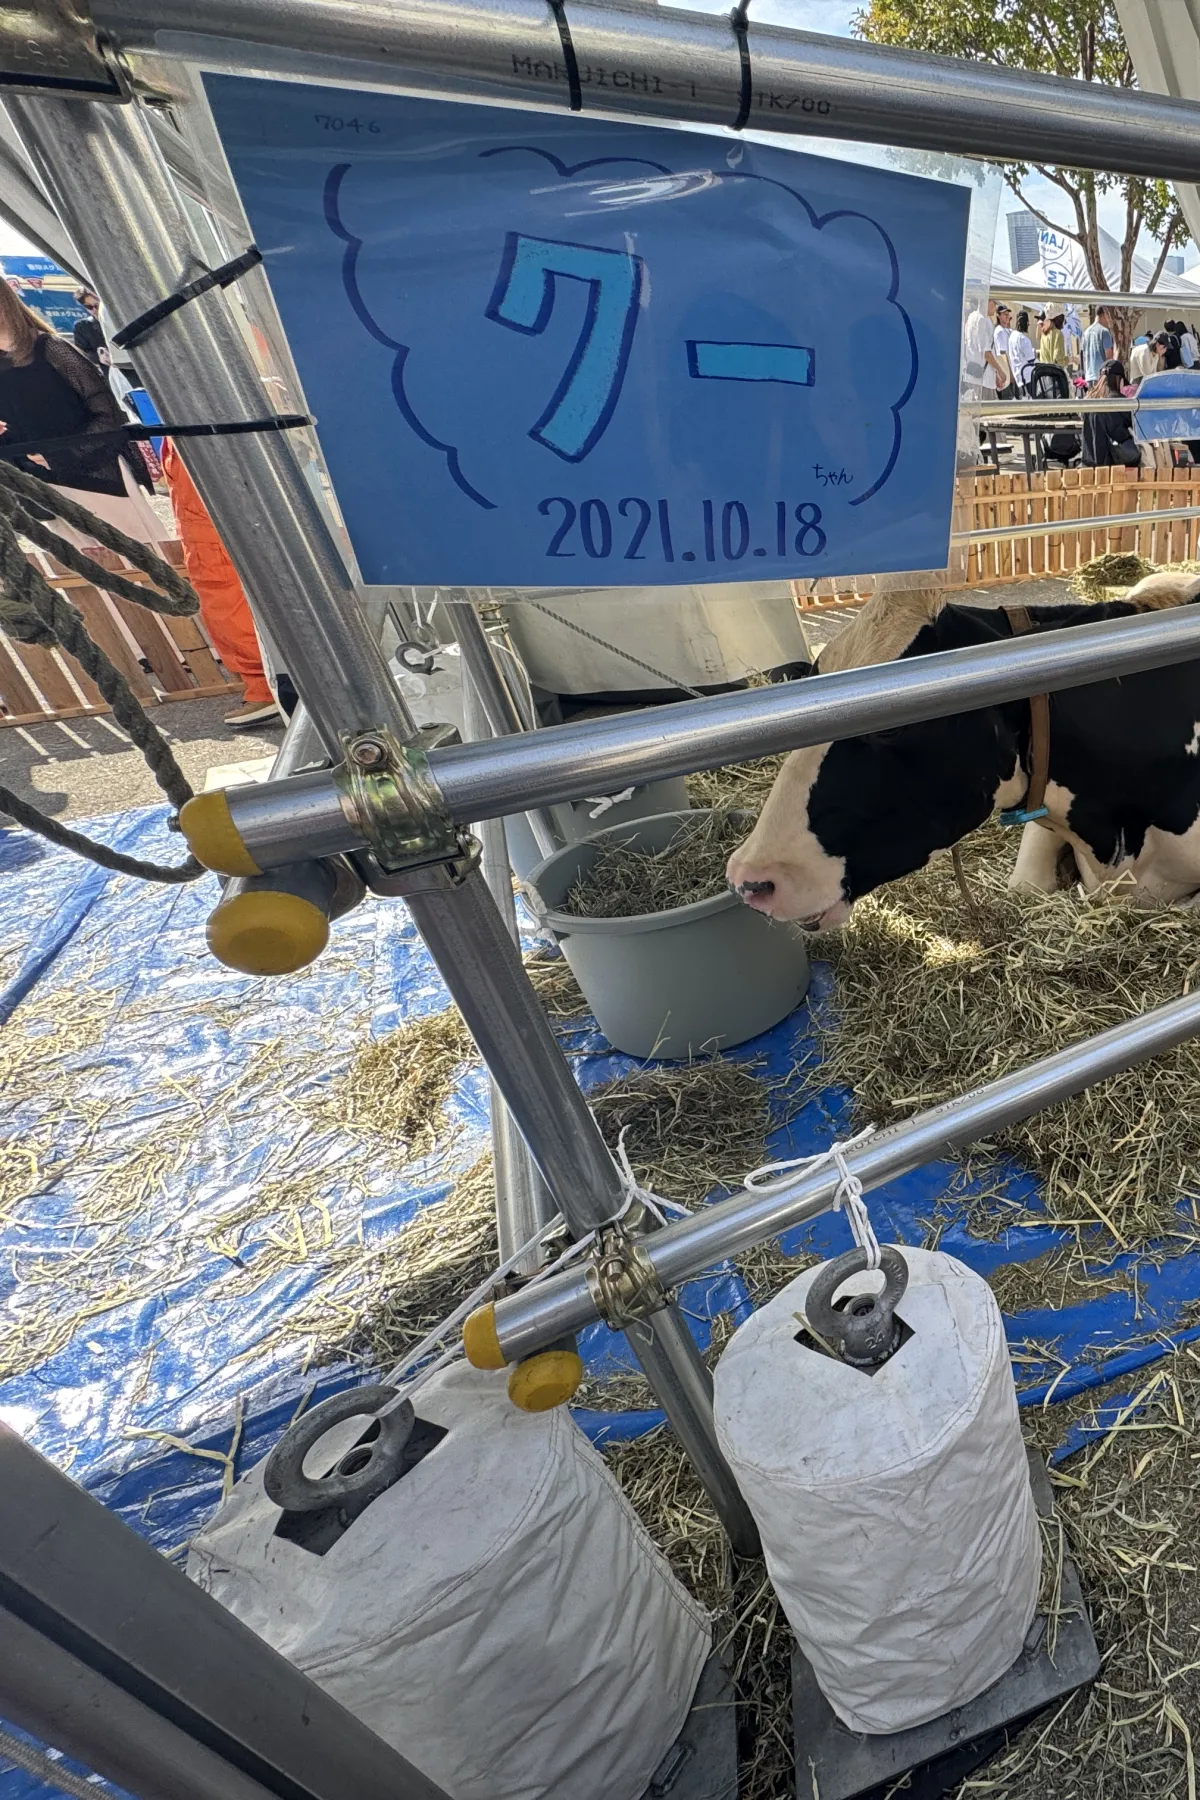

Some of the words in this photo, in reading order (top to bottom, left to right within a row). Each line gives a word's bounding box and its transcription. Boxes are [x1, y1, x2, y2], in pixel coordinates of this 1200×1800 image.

[314, 114, 382, 134] 7046
[812, 463, 853, 487] ちゃん
[537, 496, 828, 563] 2021.10.18
